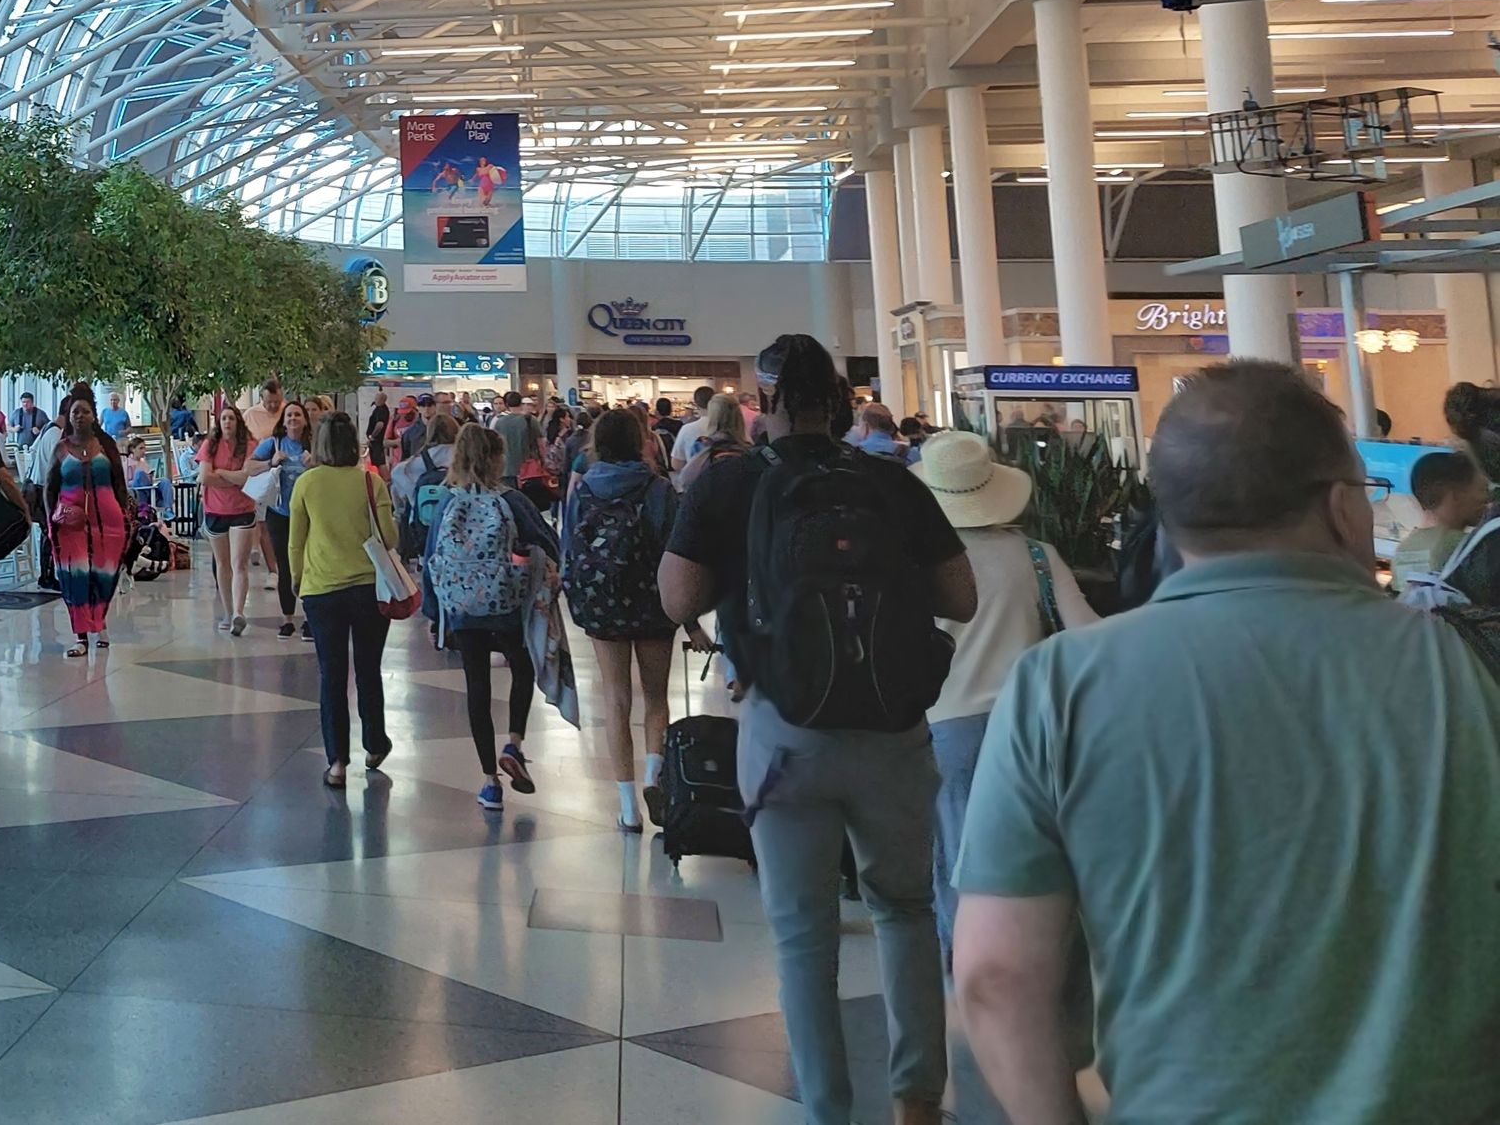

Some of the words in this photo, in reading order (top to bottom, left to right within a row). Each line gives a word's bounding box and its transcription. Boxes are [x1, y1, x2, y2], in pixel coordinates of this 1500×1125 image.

[406, 121, 436, 131] More
[464, 120, 493, 131] More
[407, 131, 437, 142] Perks.
[467, 130, 491, 144] Play.
[652, 318, 687, 331] CITY
[990, 372, 1059, 384] CURRENCY
[1060, 373, 1132, 385] EXCHANGE
